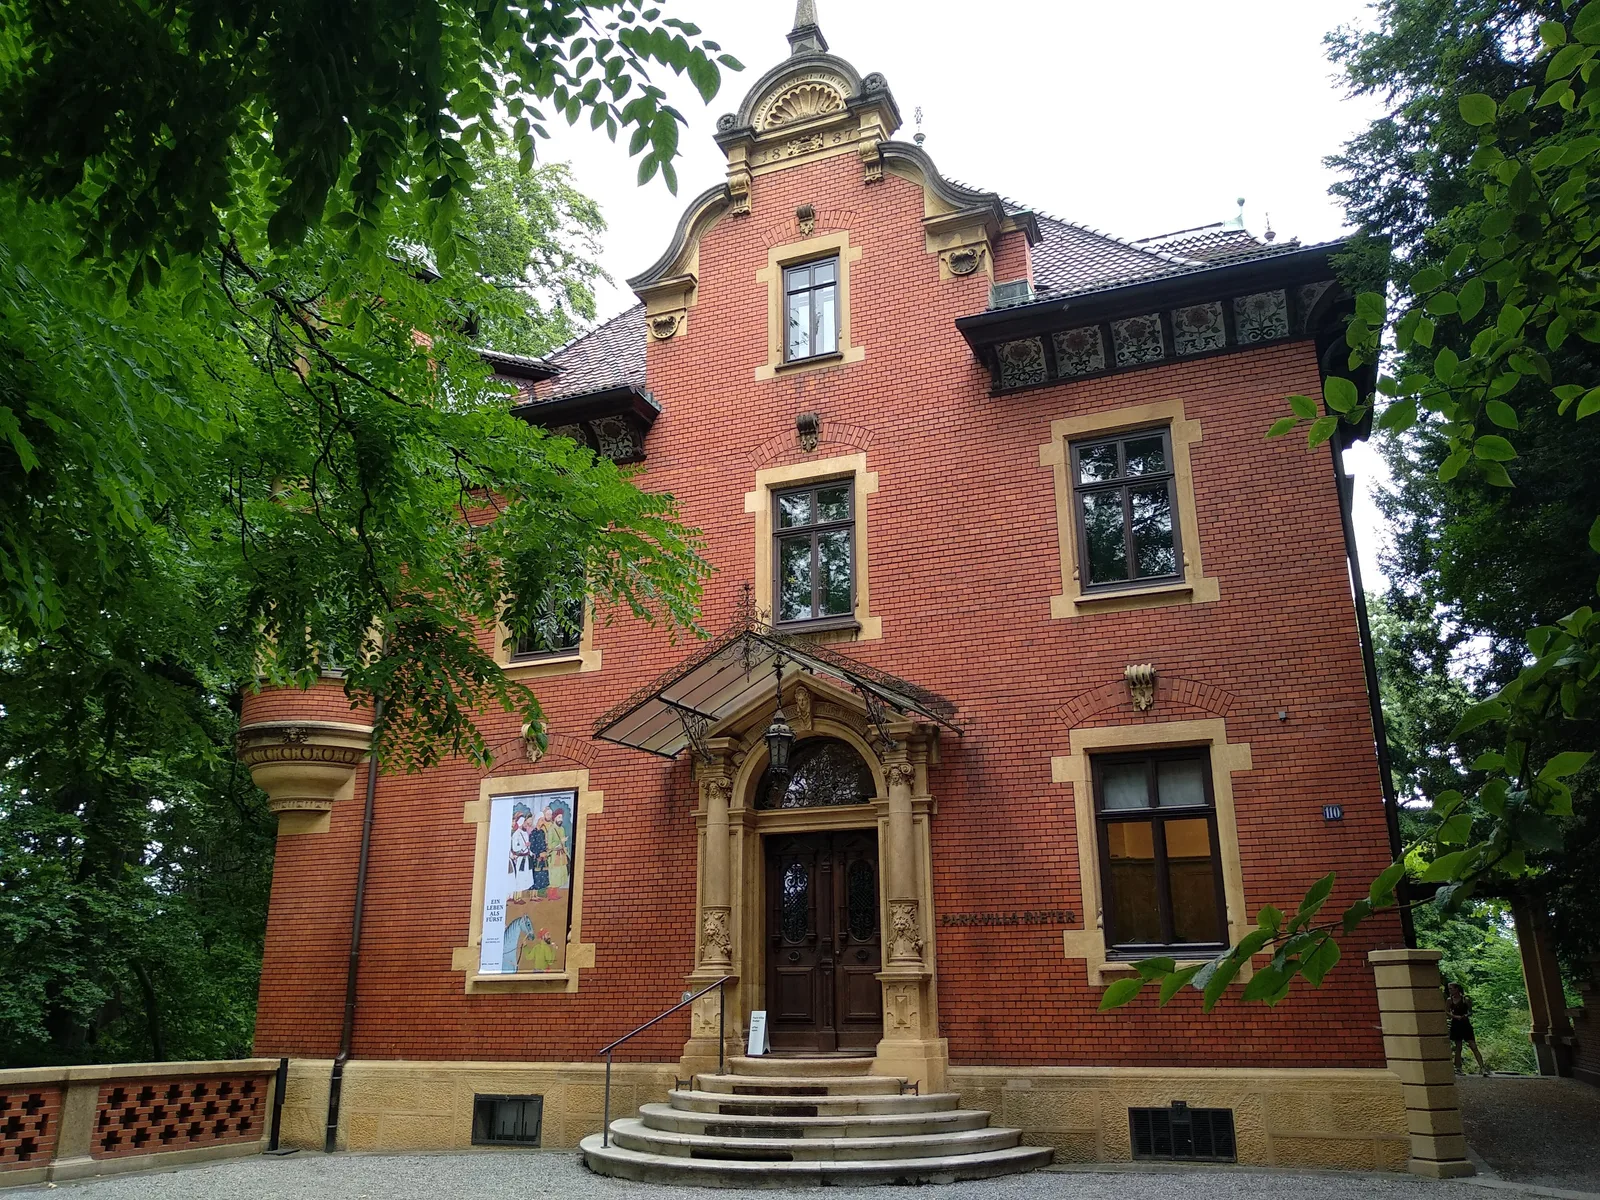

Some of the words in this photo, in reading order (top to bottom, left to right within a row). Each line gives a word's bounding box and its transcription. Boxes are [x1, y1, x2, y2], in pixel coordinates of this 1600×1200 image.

[833, 128, 854, 143] 87
[1325, 806, 1340, 819] 110
[1023, 909, 1075, 925] RIETER
